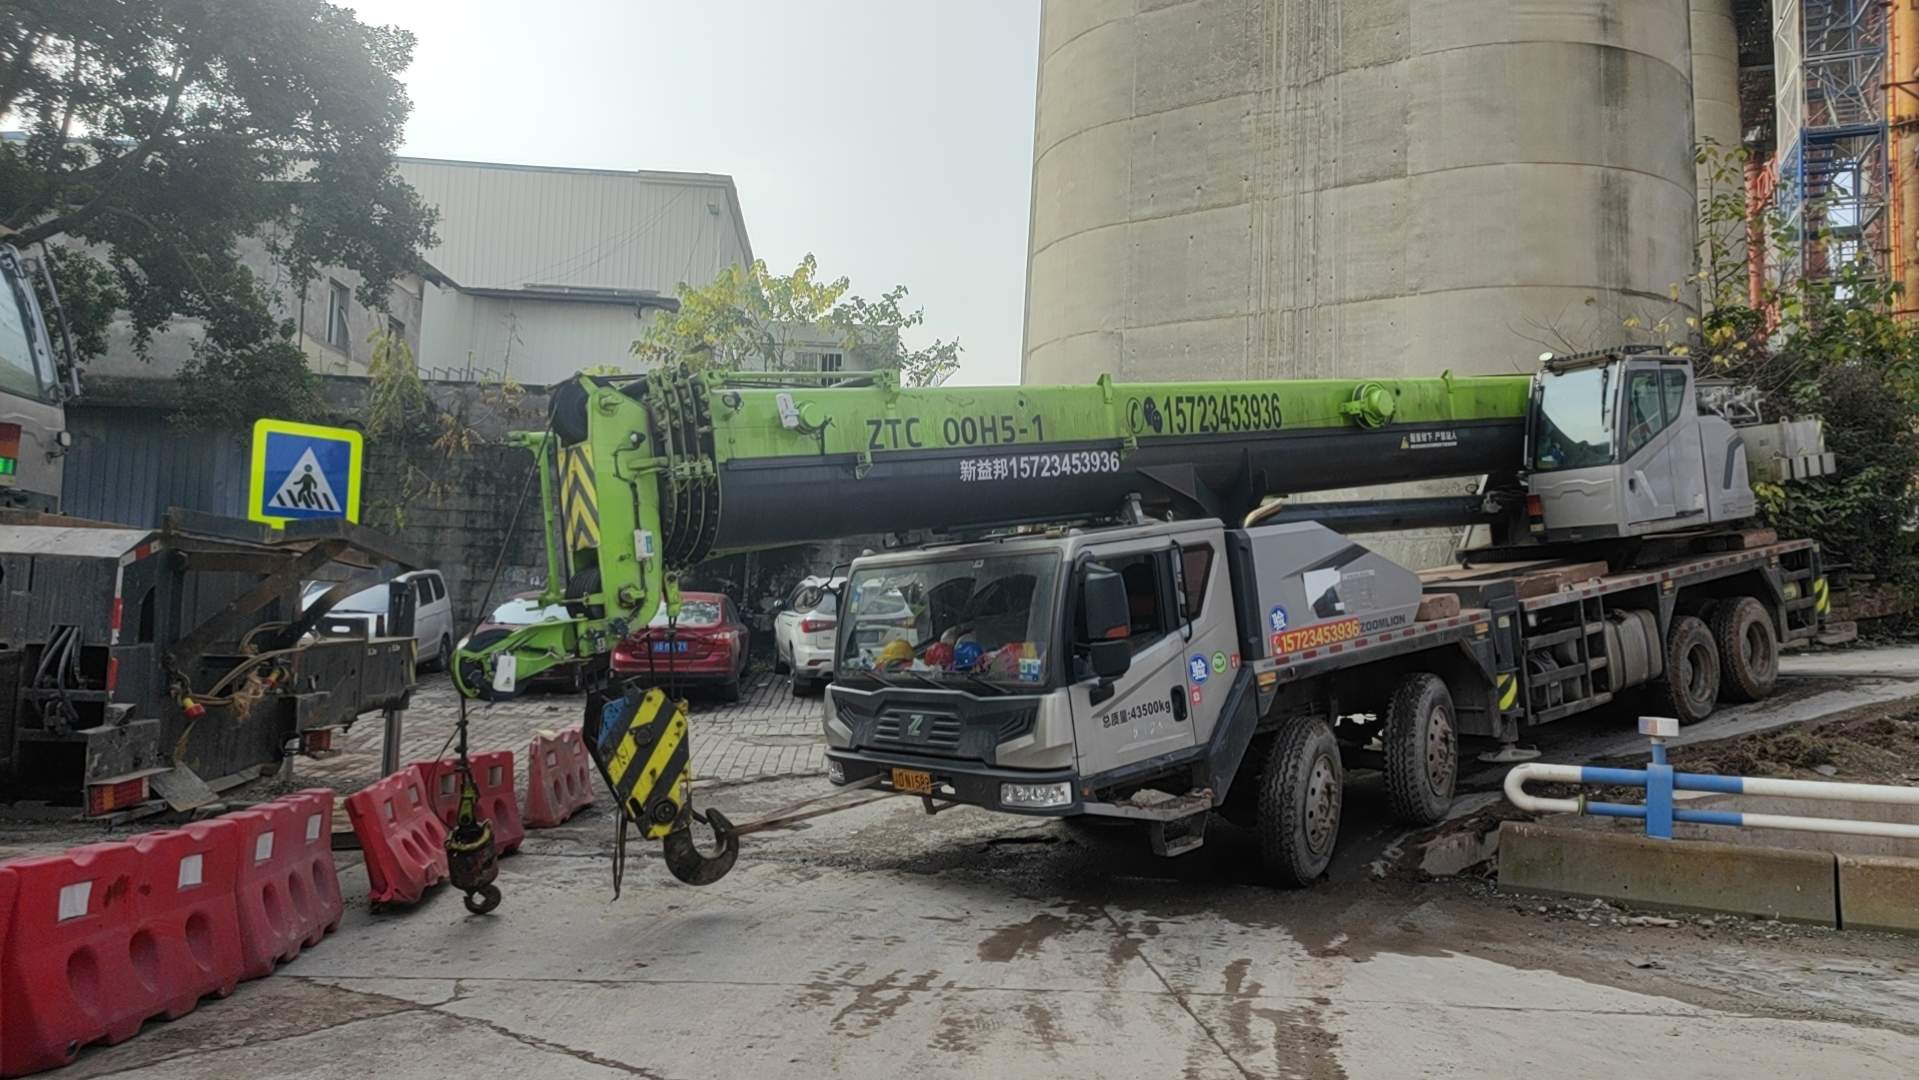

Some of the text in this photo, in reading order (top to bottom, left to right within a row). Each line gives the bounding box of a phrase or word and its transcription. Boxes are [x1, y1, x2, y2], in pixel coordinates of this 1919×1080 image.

[1164, 393, 1282, 433] 15723453936
[866, 417, 922, 449] ZTC
[1281, 620, 1360, 653] 15723453936
